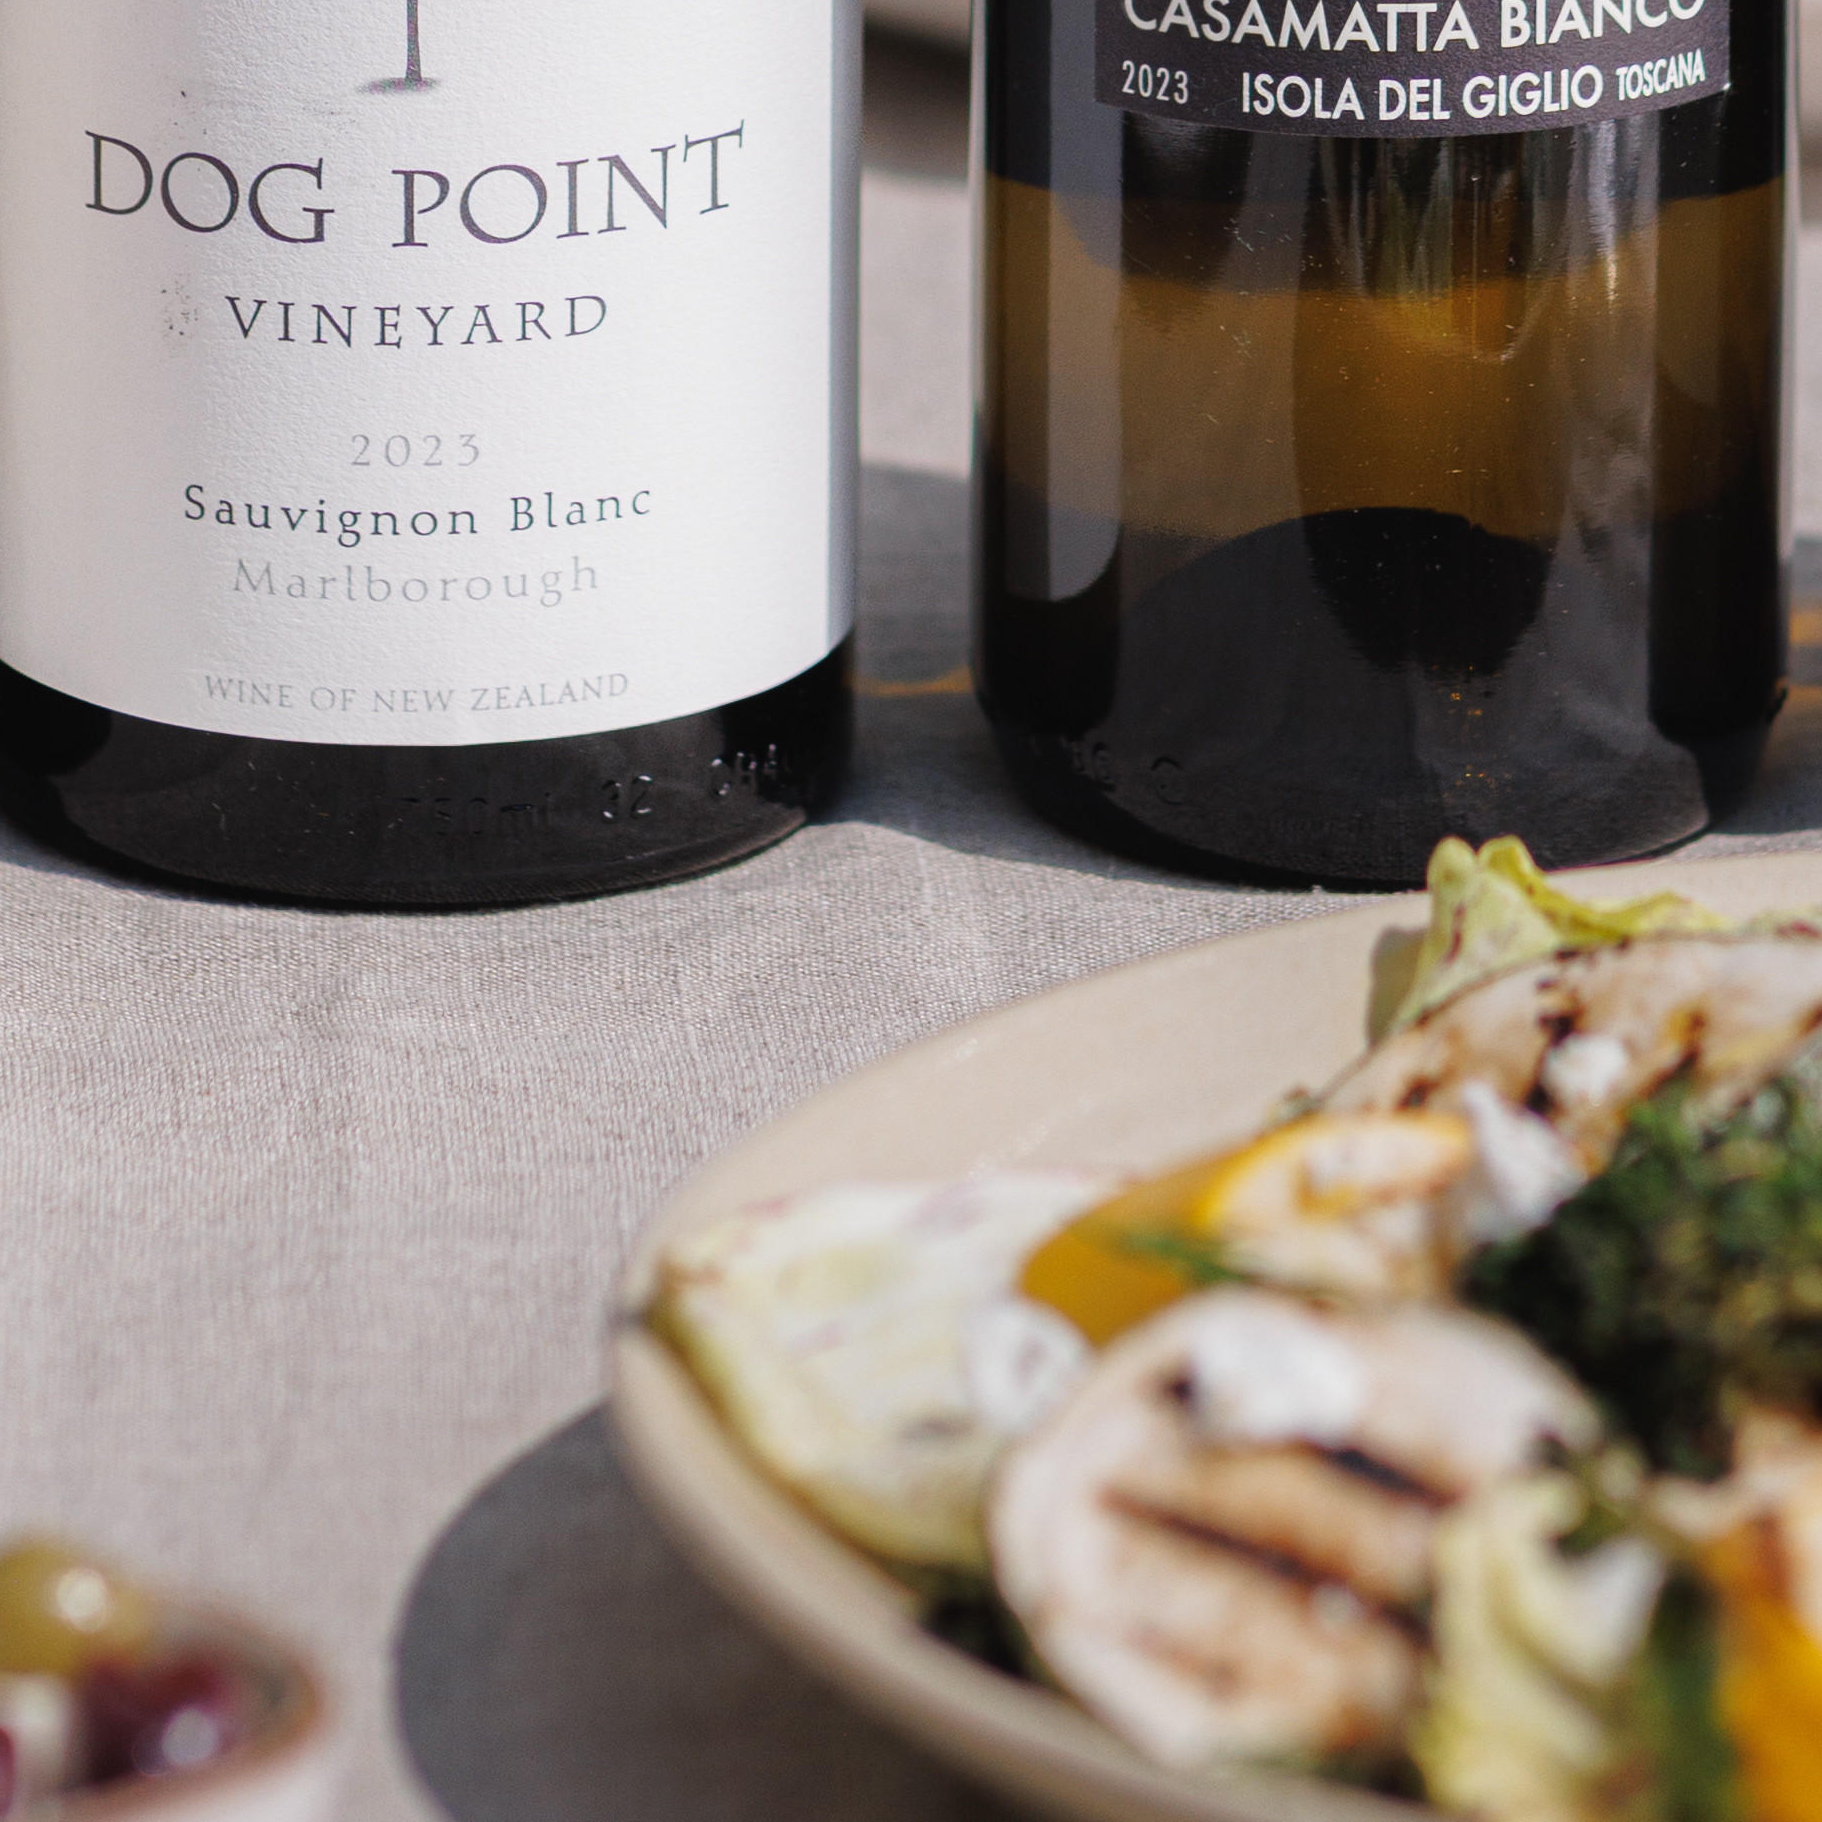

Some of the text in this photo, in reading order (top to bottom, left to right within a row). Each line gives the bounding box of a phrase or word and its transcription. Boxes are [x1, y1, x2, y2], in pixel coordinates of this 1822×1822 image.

[1121, 48, 1707, 122] 2023 ISOLA DEL GIGLIO TOSCANA
[82, 119, 747, 248] DOG POINT
[224, 293, 610, 350] VINEYARD
[349, 432, 482, 469] 2023
[182, 482, 652, 549] Sauvignon Blanc
[231, 554, 600, 609] Marlborough
[203, 672, 631, 714] WINE OF NEW ZEALAND
